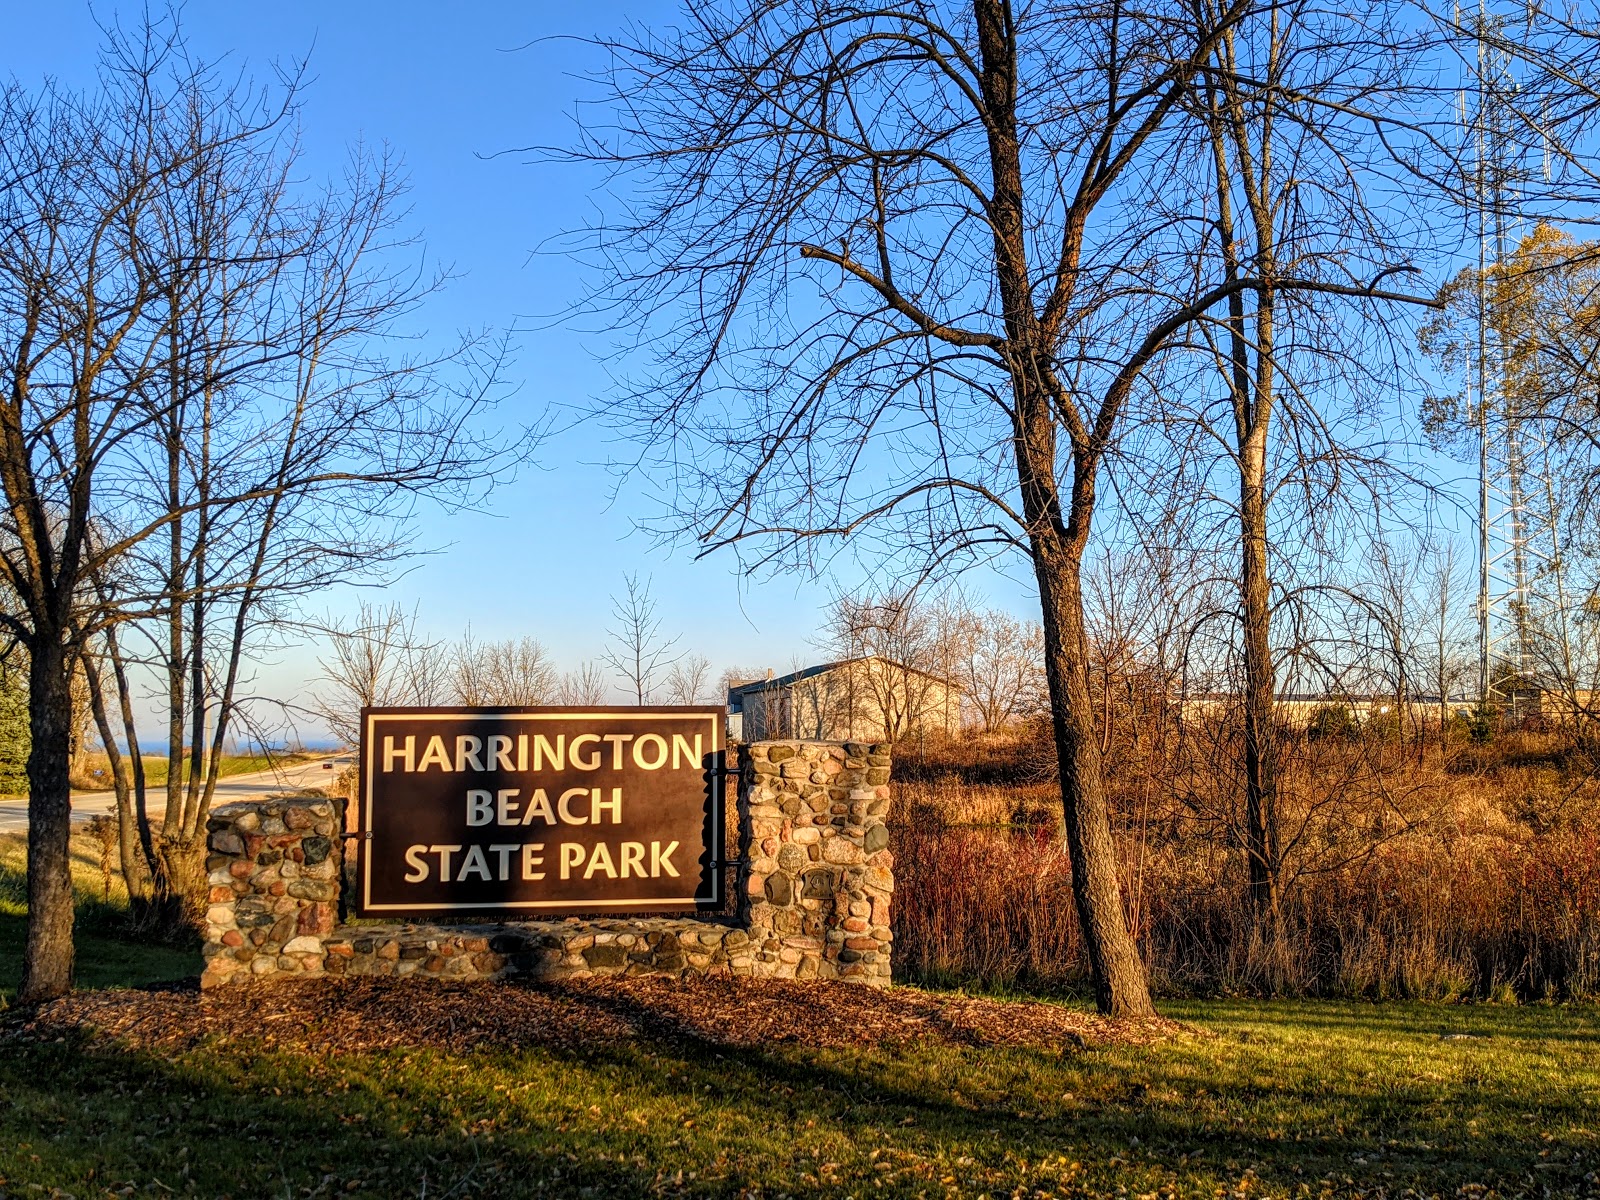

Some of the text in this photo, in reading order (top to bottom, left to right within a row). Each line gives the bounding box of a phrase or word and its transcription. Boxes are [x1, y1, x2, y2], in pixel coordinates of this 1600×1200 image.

[383, 733, 703, 773] HARRINGTON
[466, 787, 622, 827] BEACH
[404, 840, 681, 883] STATE PARK
